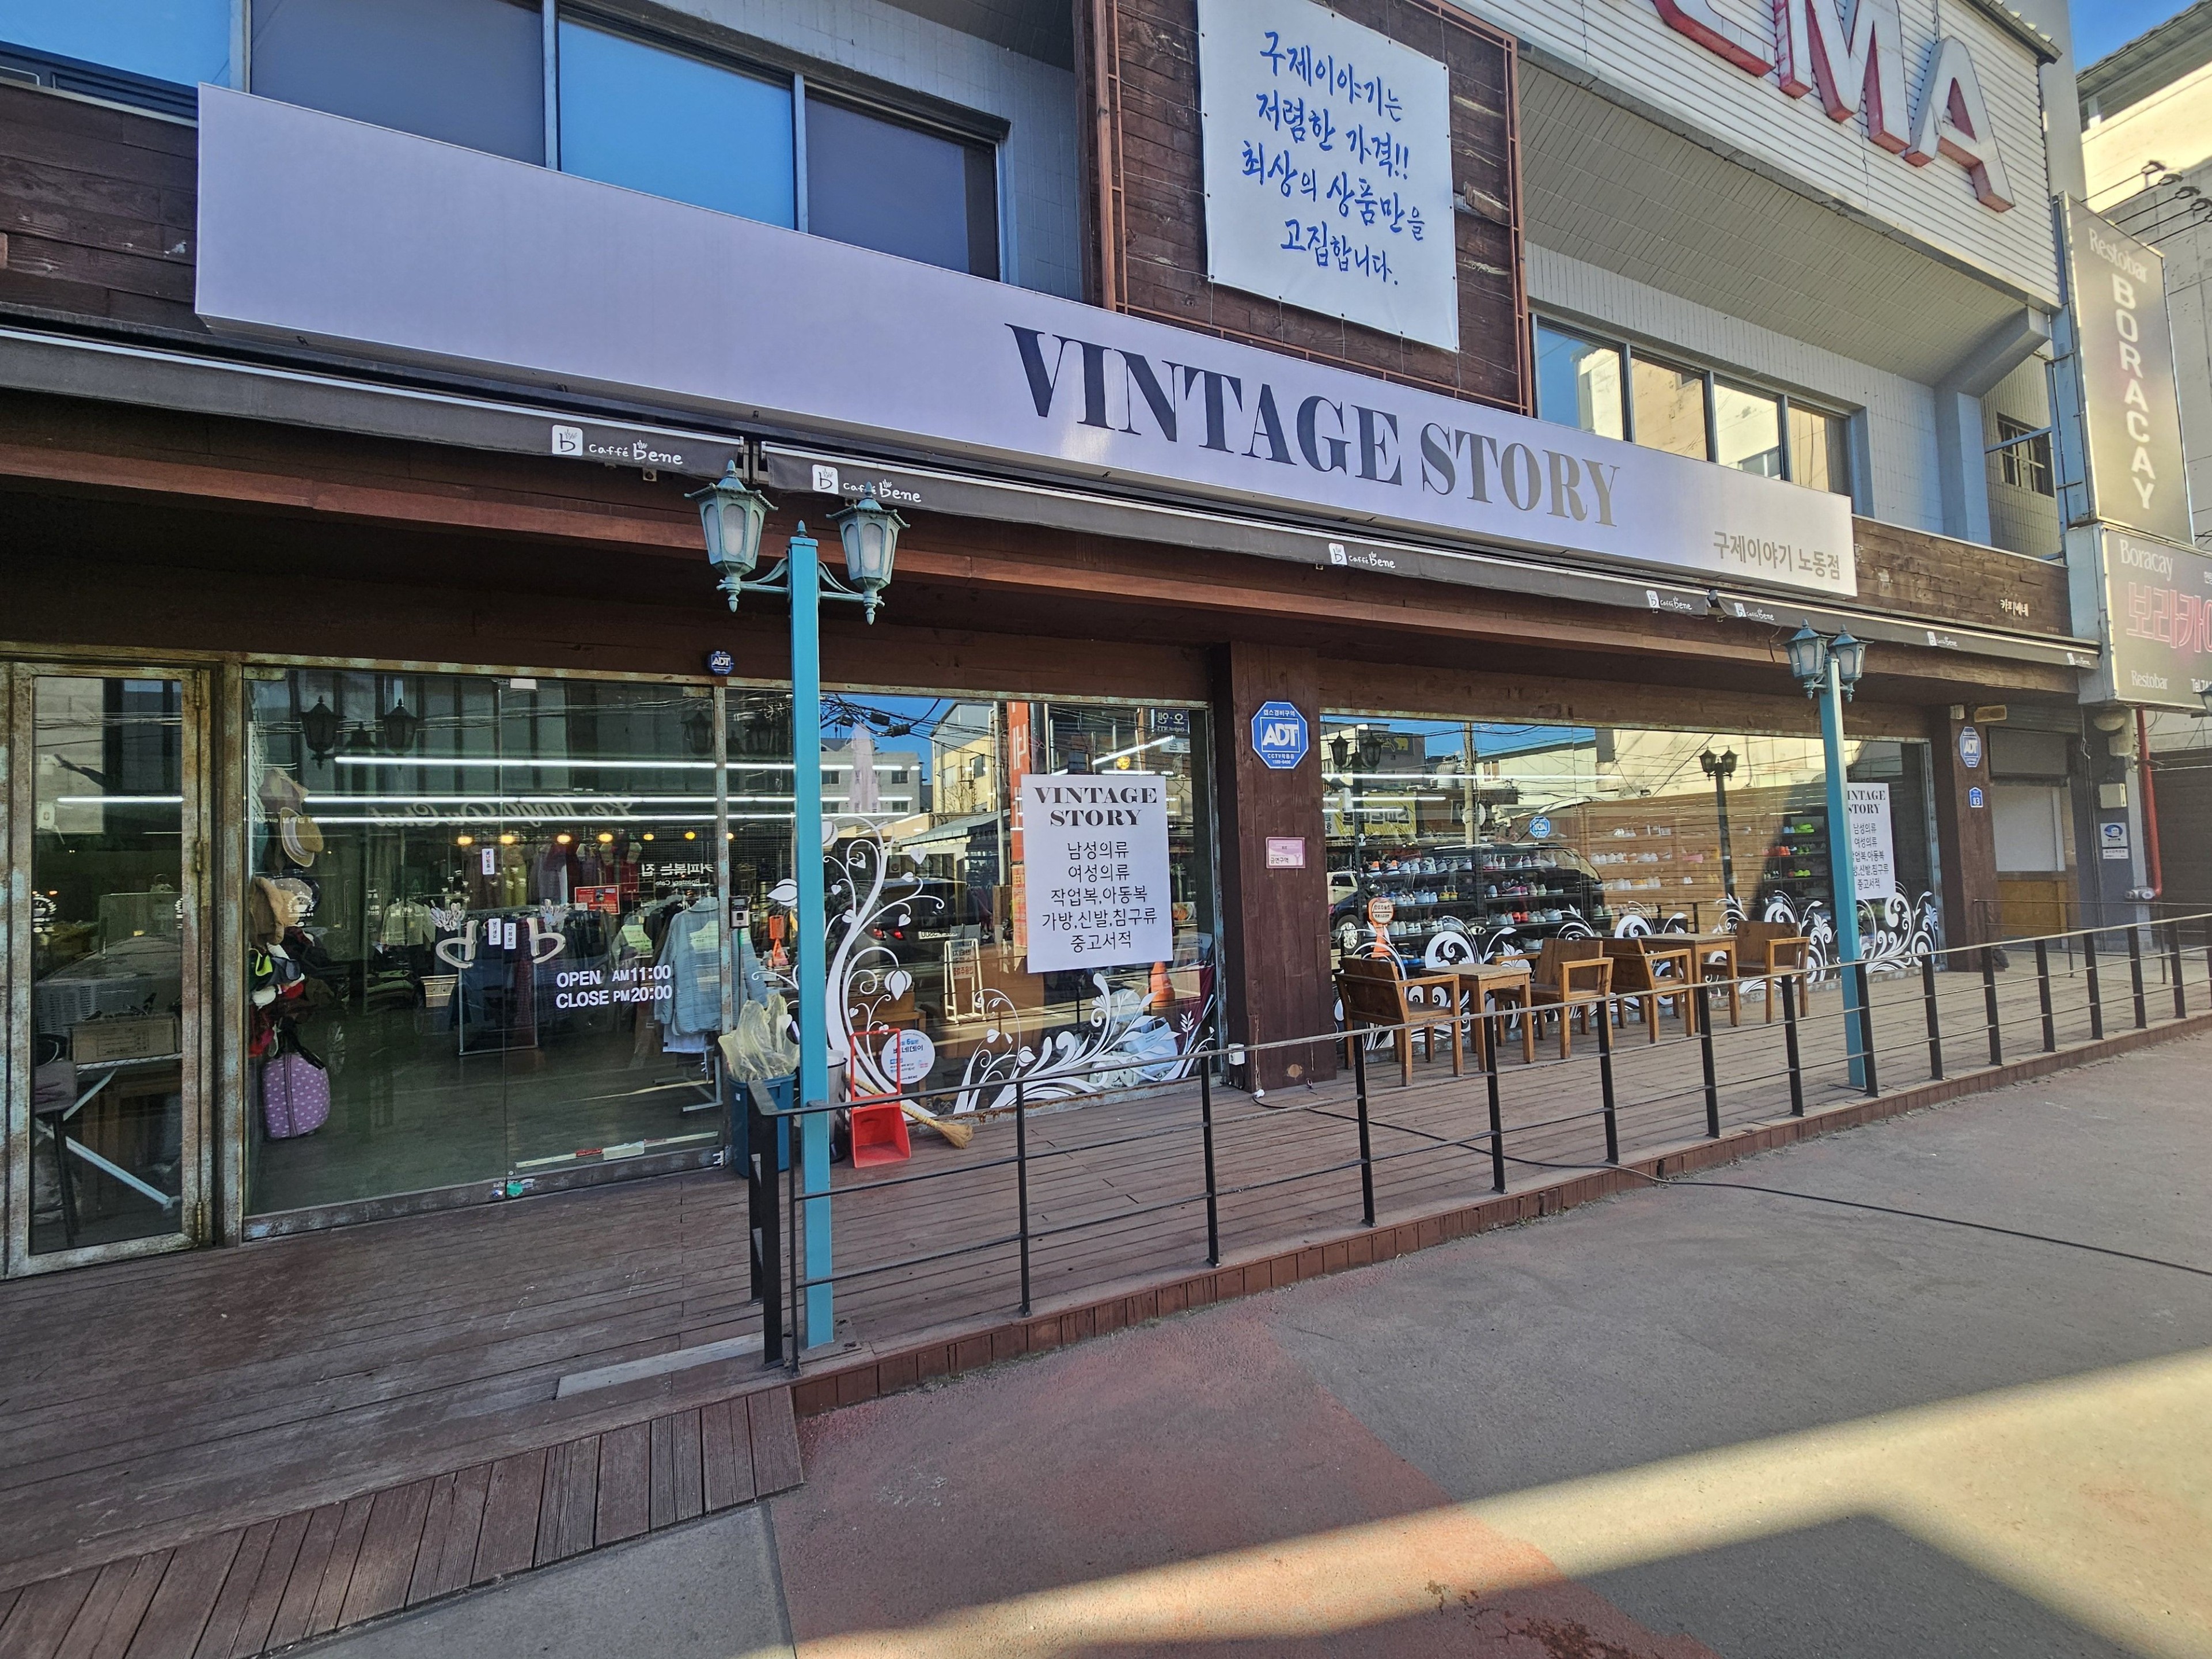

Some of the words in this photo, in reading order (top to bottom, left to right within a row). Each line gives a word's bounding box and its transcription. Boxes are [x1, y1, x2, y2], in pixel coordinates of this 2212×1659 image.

[1260, 31, 1403, 122] 구제이야기는
[1256, 90, 1334, 150] 저렴한
[1346, 127, 1408, 180] 가격!!
[1243, 141, 1317, 202] 최상의
[1327, 172, 1425, 241] 상품만을
[1280, 219, 1397, 285] 고집합니다.
[2089, 228, 2148, 283] Restobar
[2112, 273, 2156, 509] BORACAY
[1005, 323, 1402, 485] VINTAGE
[1421, 422, 1620, 526] STORY
[1713, 531, 1792, 571] 구제이야기
[1798, 548, 1840, 580] 노동점
[2119, 539, 2173, 581] Boracay
[712, 657, 730, 666] ADT
[2131, 670, 2168, 689] Restobar
[1263, 723, 1298, 747] ADT
[1964, 740, 1978, 753] ADT
[1033, 787, 1157, 804] VINTAGE
[1847, 790, 1885, 801] INTAGE
[1050, 809, 1142, 826] STORY
[1853, 823, 1877, 834] 남성의류
[1067, 841, 1129, 860] 남성의류
[1854, 837, 1877, 848] 여성의류
[1068, 863, 1130, 882] 여성의류
[1853, 864, 1889, 876] 방,신발,침구류
[1857, 877, 1880, 890] 중고서적
[1051, 885, 1147, 907] 작업복,아동복
[1042, 908, 1157, 931] 가방,신발,침구류
[1070, 931, 1131, 953] 중고서적
[556, 970, 601, 988] OPEN
[556, 990, 609, 1009] CLOSE
